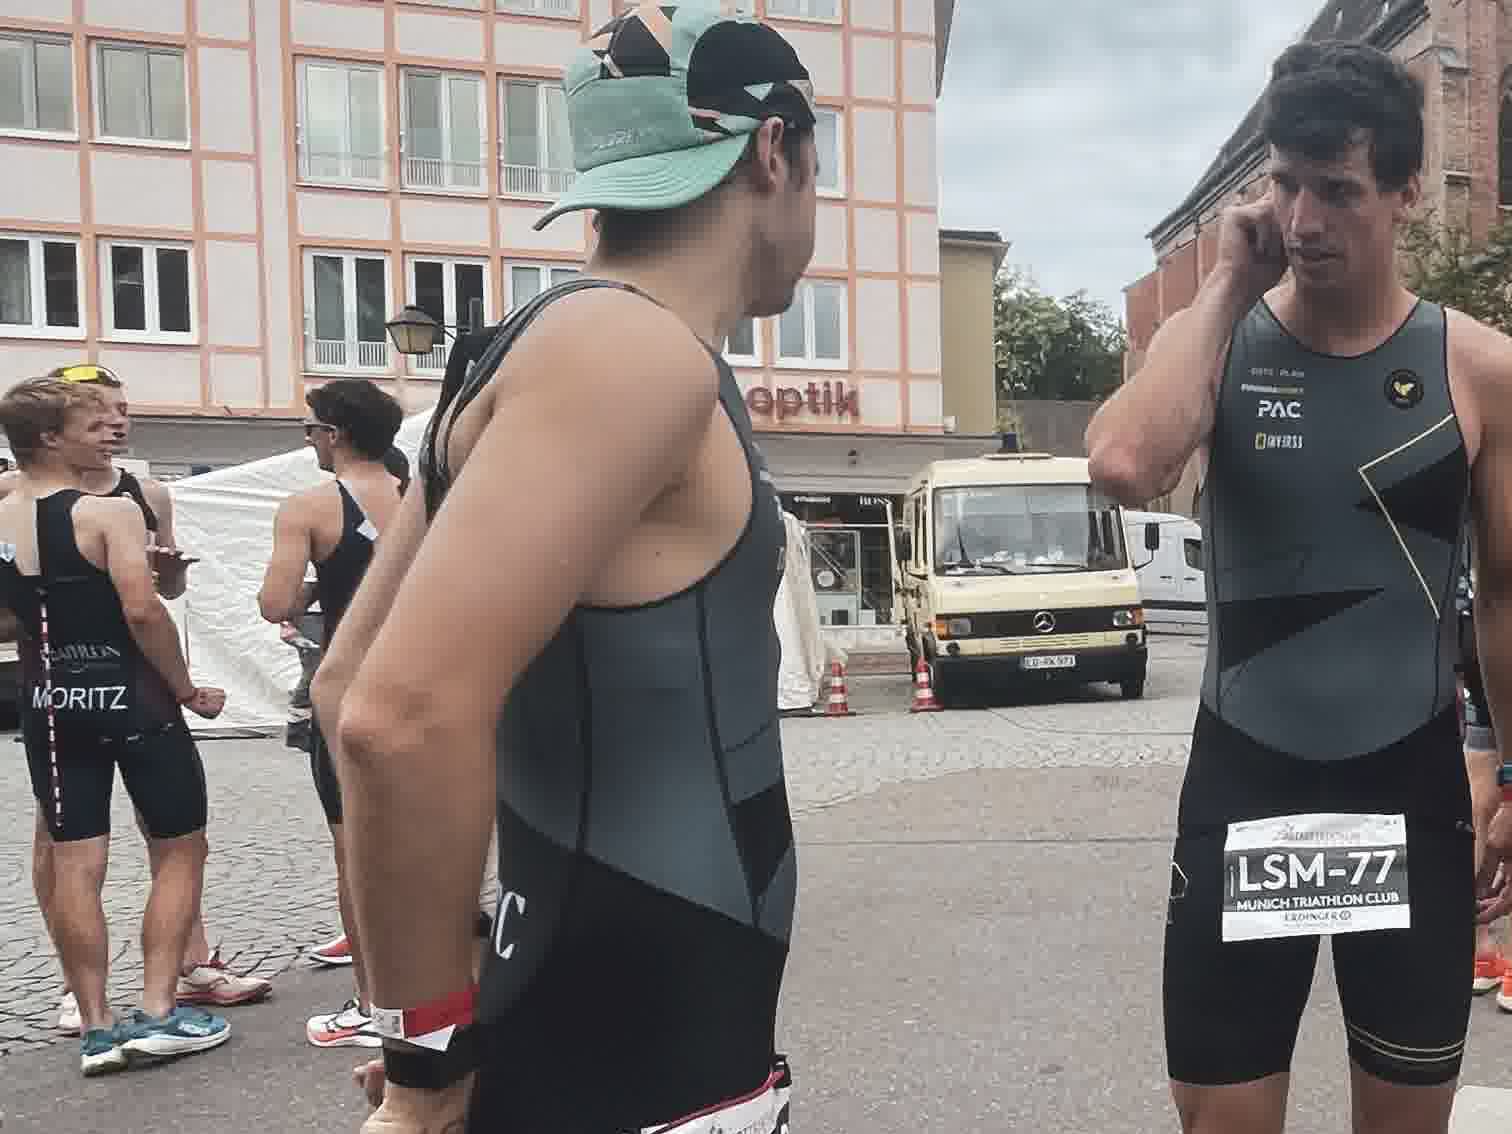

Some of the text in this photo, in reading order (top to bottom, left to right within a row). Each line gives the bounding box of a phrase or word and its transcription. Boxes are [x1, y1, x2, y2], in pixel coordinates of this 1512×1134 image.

[746, 381, 859, 420] optik
[1258, 400, 1301, 417] PAC
[32, 686, 129, 710] MORITZ
[1239, 850, 1397, 891] LSM-77
[1236, 892, 1399, 912] MUNICH TRIATHLON CLUB
